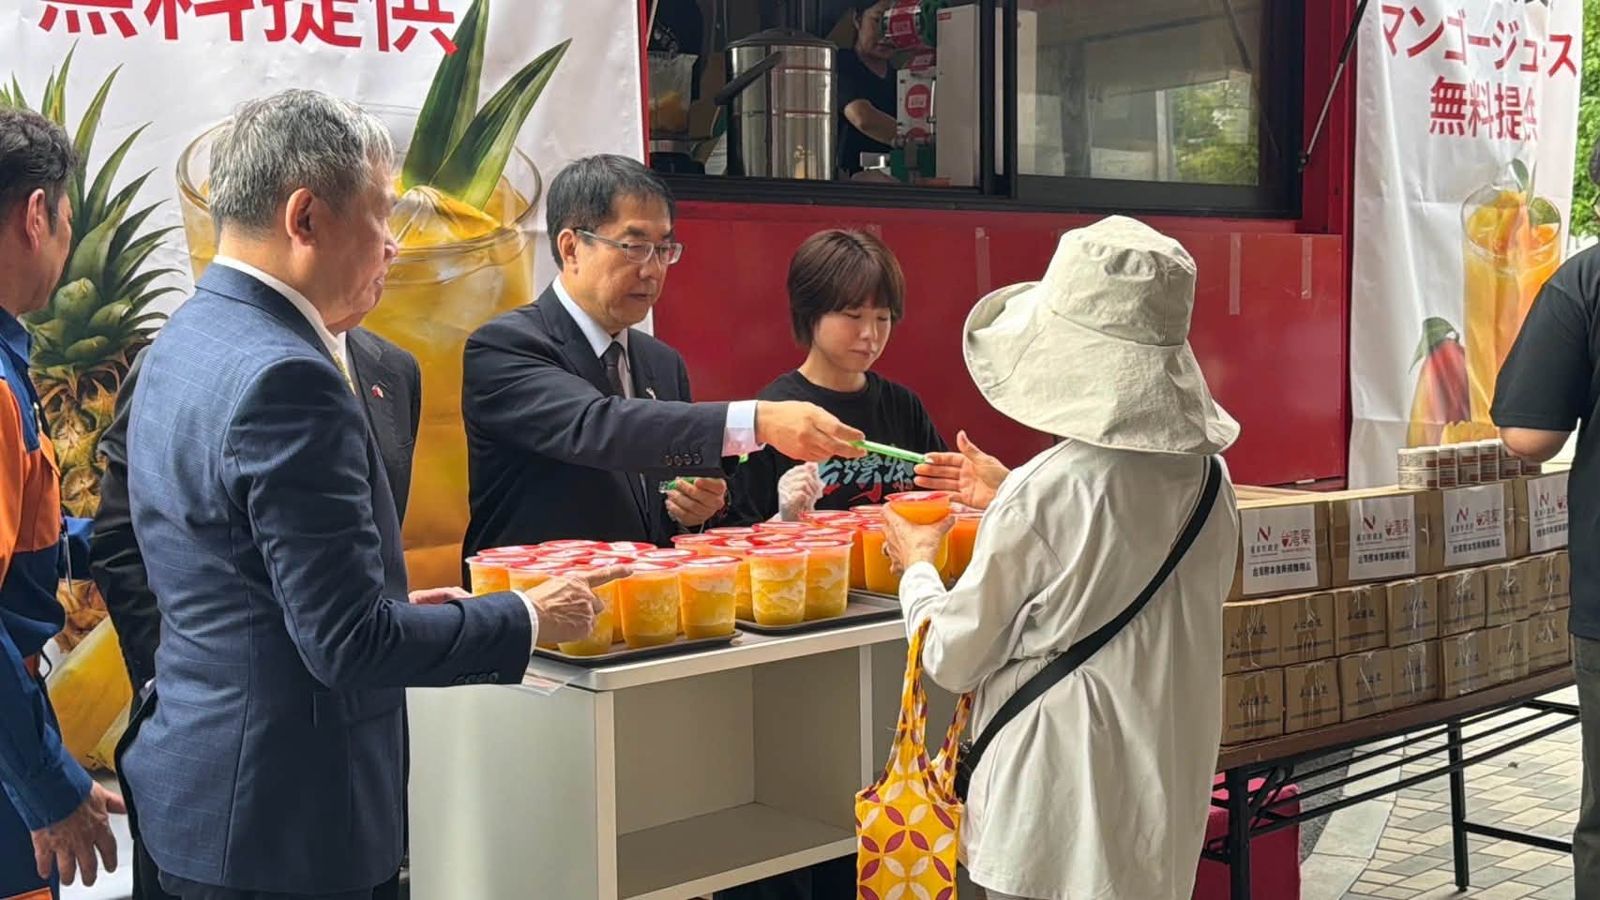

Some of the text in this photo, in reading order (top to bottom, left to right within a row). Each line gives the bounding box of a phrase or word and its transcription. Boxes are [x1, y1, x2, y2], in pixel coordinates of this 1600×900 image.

[1382, 5, 1577, 77] マンゴージュス
